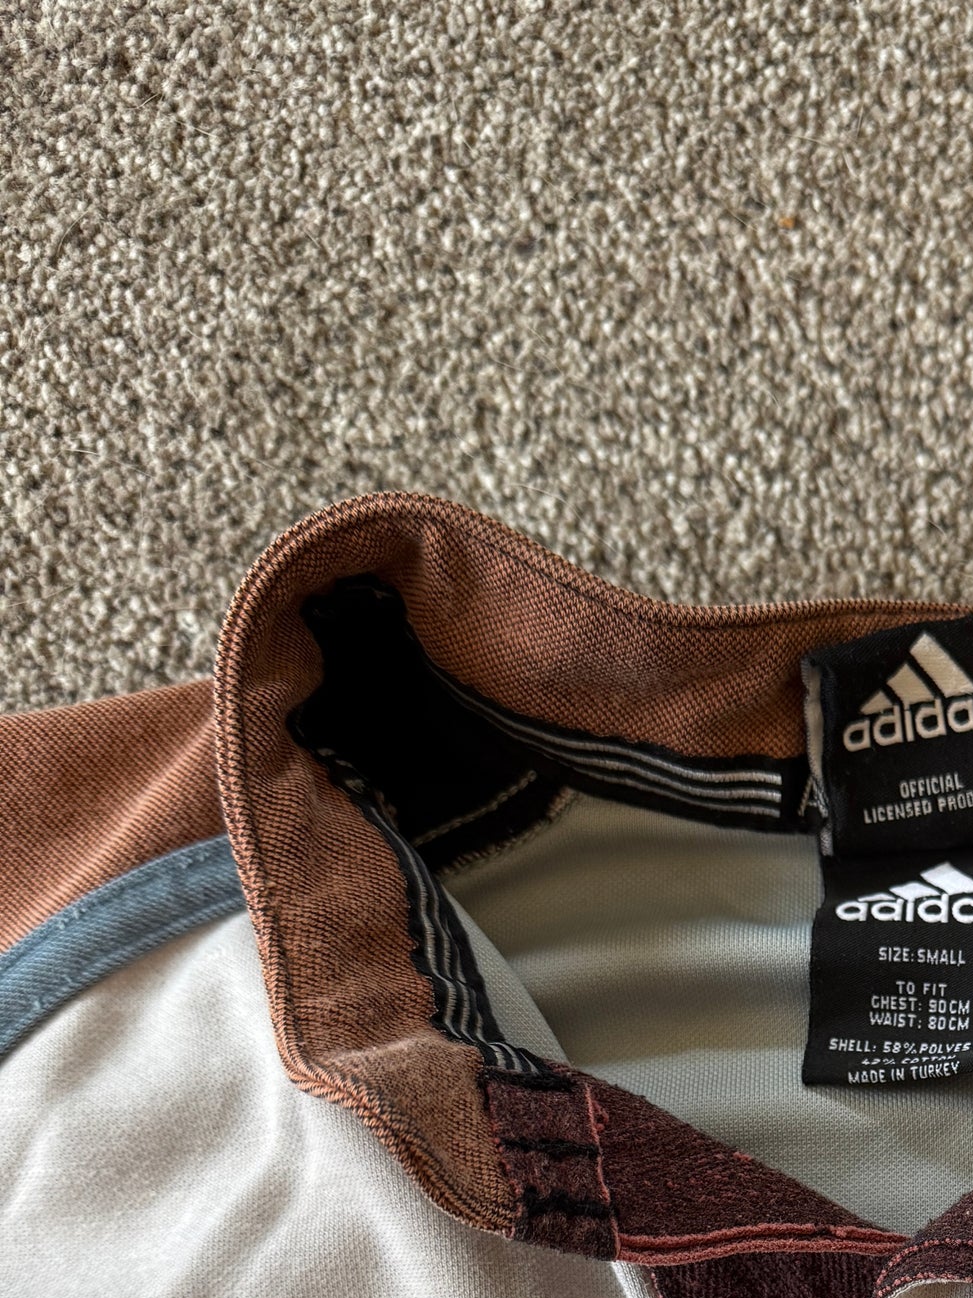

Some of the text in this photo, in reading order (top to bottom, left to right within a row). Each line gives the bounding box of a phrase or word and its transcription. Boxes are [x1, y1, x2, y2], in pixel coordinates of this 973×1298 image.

[900, 773, 963, 798] OFFICIAL
[863, 802, 932, 824] LICENSED
[896, 981, 948, 996] TO FIT
[871, 996, 922, 1012] CHEST:
[869, 1012, 922, 1029] WAIST:
[829, 1038, 876, 1053] SHELL:
[848, 1061, 960, 1084] MADE IN TURKEY
